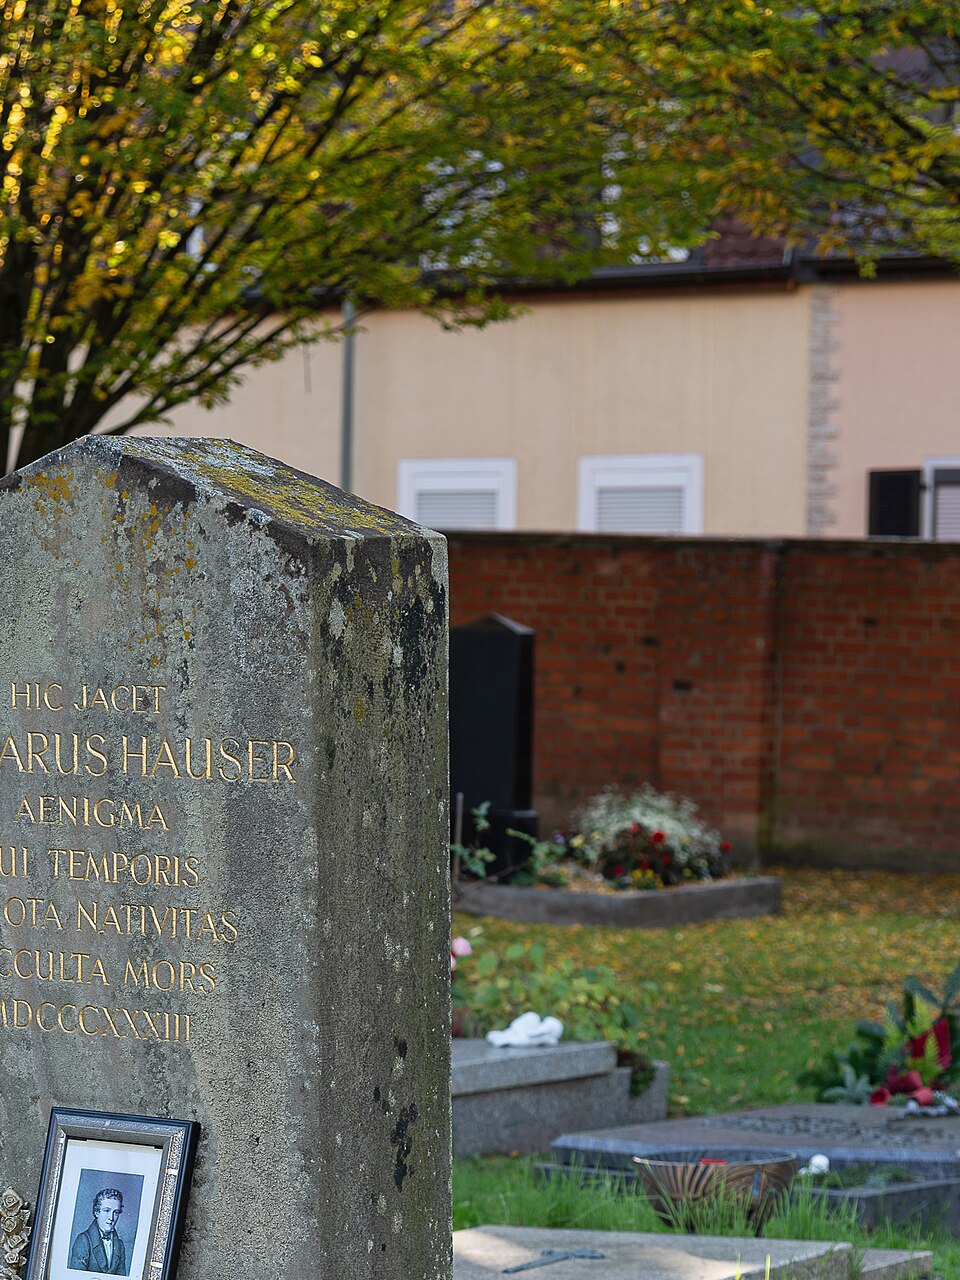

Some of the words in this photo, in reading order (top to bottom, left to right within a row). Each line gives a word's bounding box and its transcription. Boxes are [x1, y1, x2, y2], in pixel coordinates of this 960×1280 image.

[10, 682, 62, 711] HIC
[73, 684, 166, 714] JACET
[121, 735, 297, 783] HAUSER
[15, 796, 169, 831] AENIGMA
[48, 848, 200, 888] TEMPORIS
[76, 901, 238, 943] NATIVITAS
[124, 956, 216, 995] MORS
